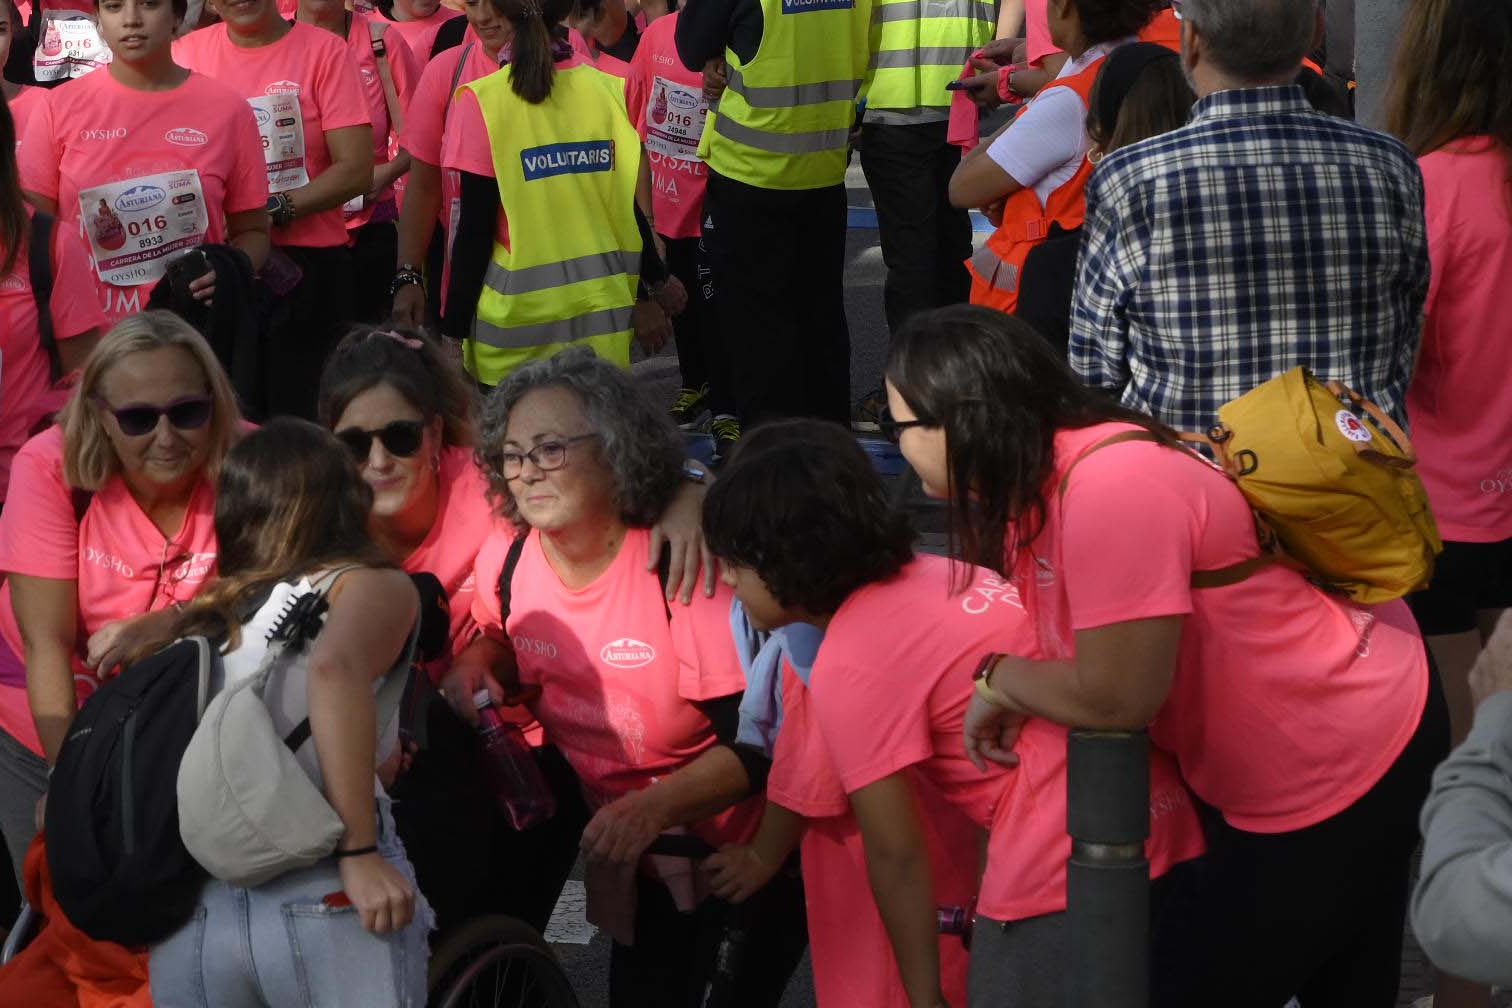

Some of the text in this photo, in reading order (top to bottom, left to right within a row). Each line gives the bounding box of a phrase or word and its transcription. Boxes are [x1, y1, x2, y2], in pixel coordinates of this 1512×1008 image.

[667, 111, 691, 126] 016
[81, 127, 127, 141] OYSHO
[168, 179, 191, 191] SUMA
[119, 194, 163, 209] ASTURIANA
[128, 215, 167, 236] 016
[139, 235, 164, 249] 8933
[110, 253, 141, 266] CARRERA
[142, 251, 152, 260] DE
[110, 267, 146, 281] OYSHO
[513, 635, 557, 657] OYSHO
[606, 650, 651, 660] ASTURIANA
